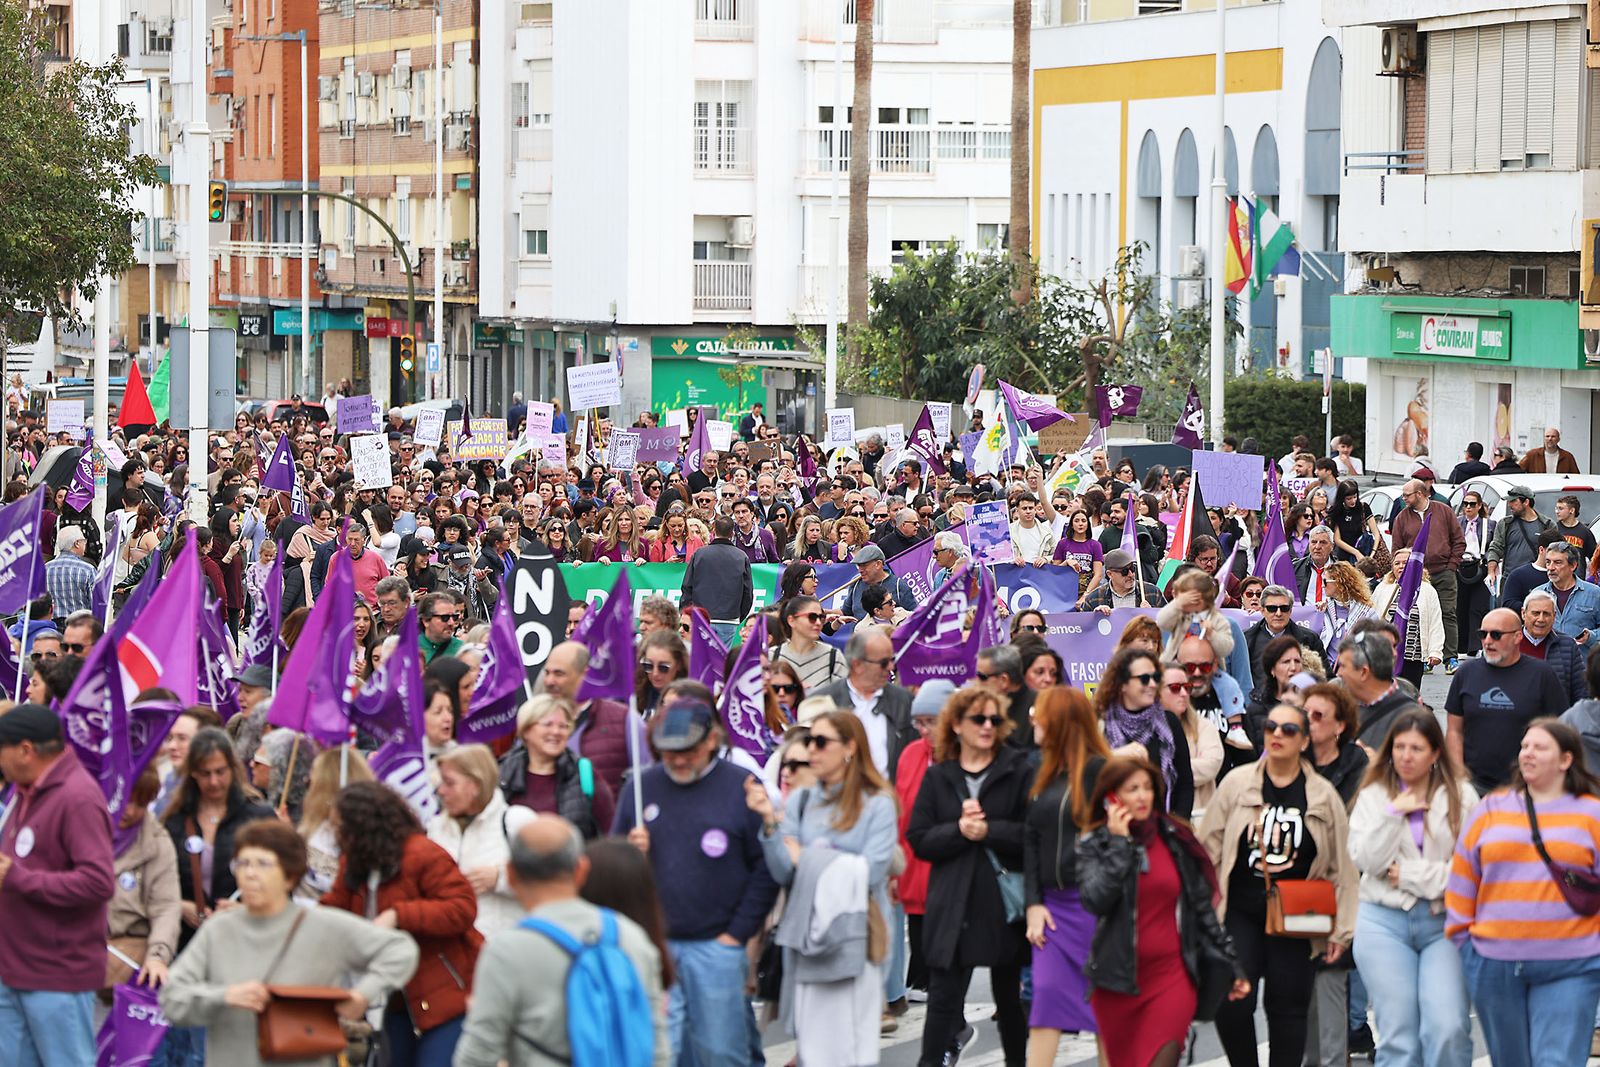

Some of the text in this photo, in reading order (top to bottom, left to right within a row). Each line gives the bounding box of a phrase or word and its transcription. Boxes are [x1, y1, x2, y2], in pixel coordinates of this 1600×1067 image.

[242, 324, 260, 335] 5€
[696, 340, 728, 353] CAJA
[1436, 329, 1474, 349] COVIRAN
[430, 347, 437, 369] P
[1282, 480, 1310, 491] EGA
[902, 572, 928, 607] PODE
